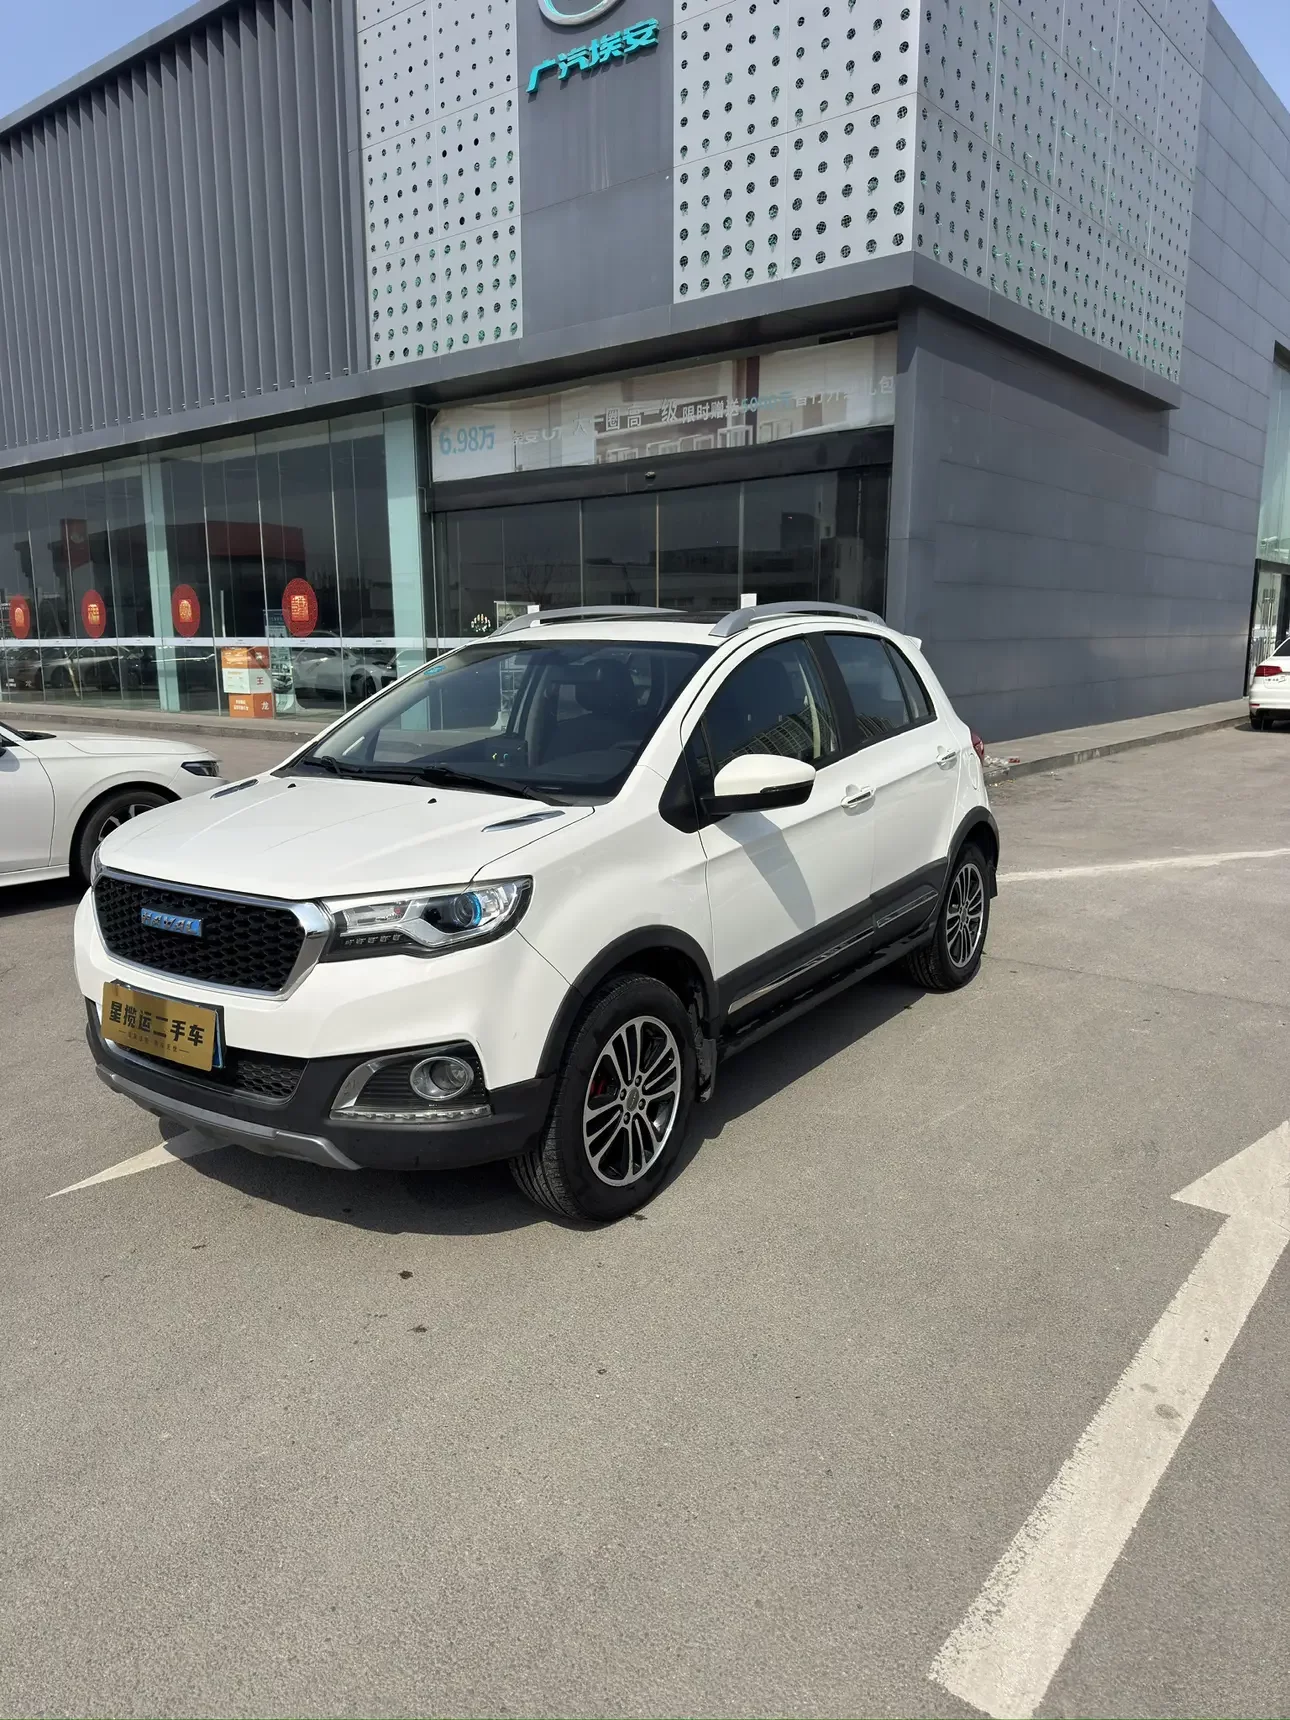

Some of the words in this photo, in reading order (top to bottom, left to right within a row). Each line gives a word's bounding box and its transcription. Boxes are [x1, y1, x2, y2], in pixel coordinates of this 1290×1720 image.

[526, 17, 660, 94] 广汽埃安
[438, 424, 496, 456] 6.98万
[141, 909, 200, 936] HAVAL
[108, 1000, 206, 1047] 星揽运二手车
